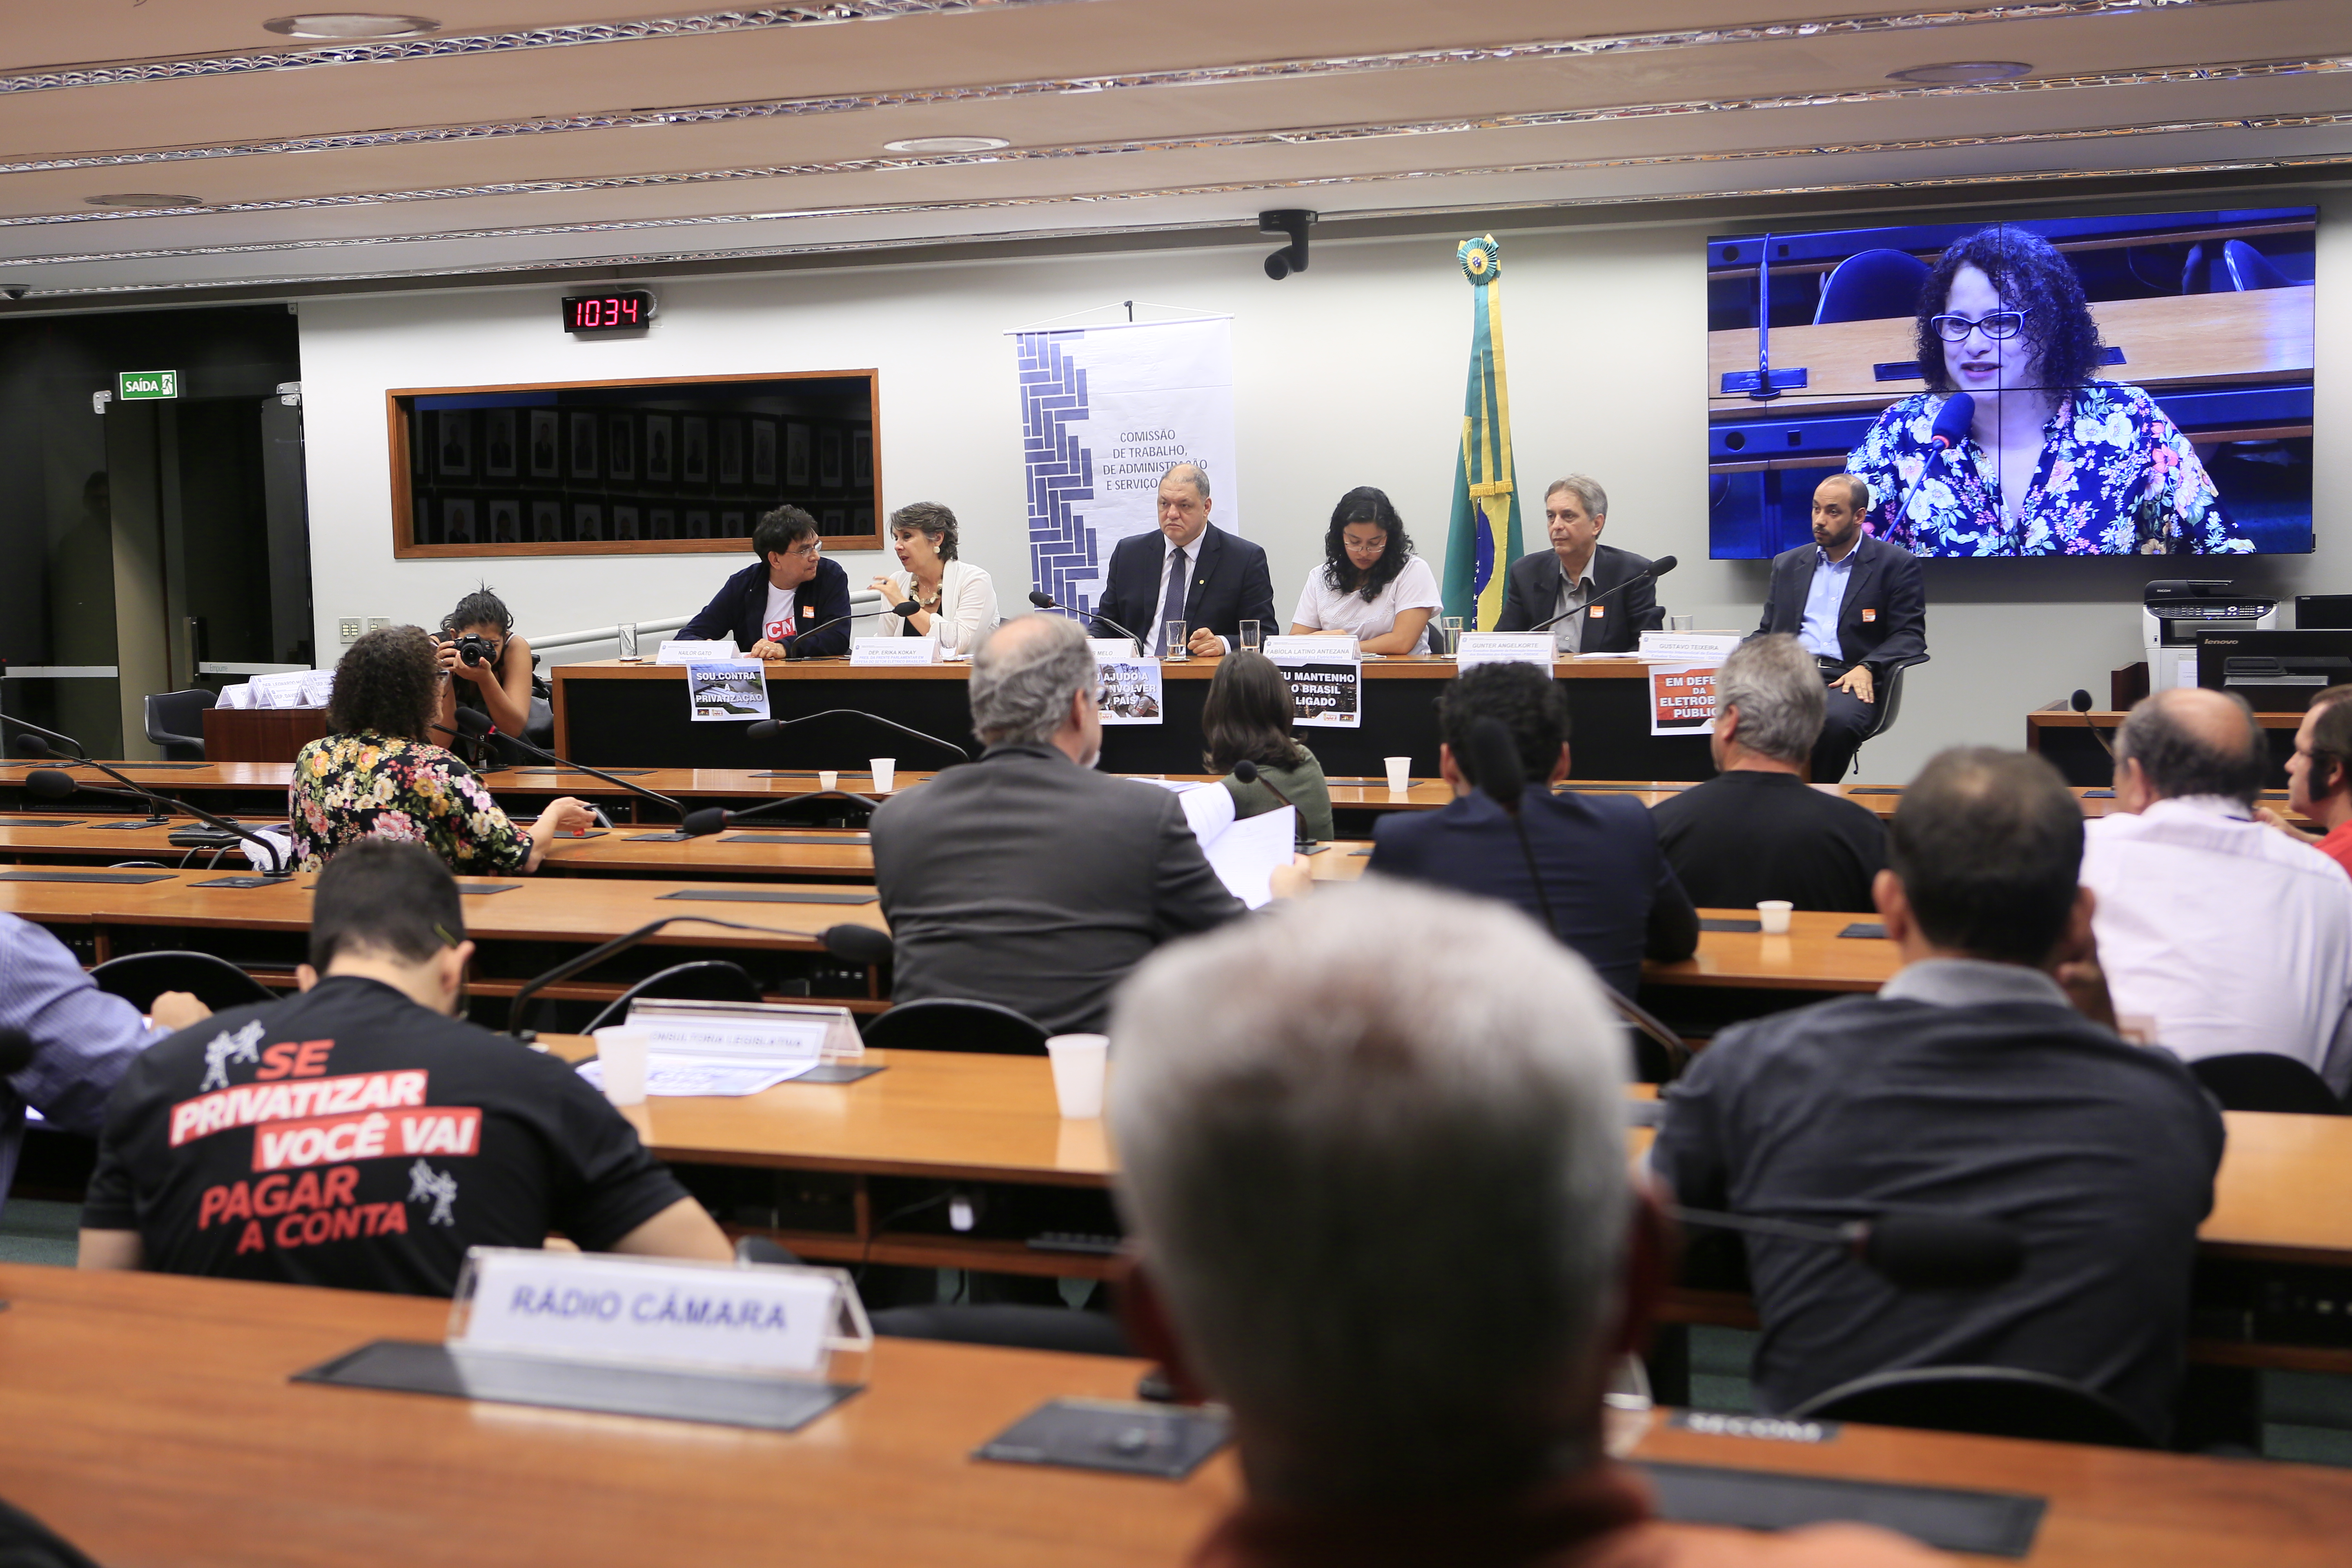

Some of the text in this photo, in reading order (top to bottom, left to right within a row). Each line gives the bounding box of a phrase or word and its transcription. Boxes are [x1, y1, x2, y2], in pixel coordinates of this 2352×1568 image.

[125, 378, 159, 392] SAÍDA
[1120, 429, 1176, 443] COMISSÃO
[1113, 445, 1187, 459] DE TRABALHO,
[1103, 459, 1207, 475] DE ADMINISTÃO
[1107, 478, 1158, 491] E SERVIÇO
[209, 664, 228, 673] Empurre
[697, 672, 756, 681] SOU CONTRA
[1104, 673, 1139, 681] AJUDO
[1141, 673, 1149, 681] A
[1294, 672, 1355, 683] MANTENHO
[1665, 676, 1717, 687] EM DEFE
[1291, 684, 1341, 694] O BRASIL
[696, 692, 763, 704] PRIVATIZAÇÃO
[1296, 697, 1336, 706] LIGADO
[1659, 695, 1716, 707] ELETROB
[256, 1039, 336, 1080] SE
[171, 1071, 427, 1146] PRIVATIZAR
[261, 1111, 477, 1170] VOCÊ VAI
[198, 1165, 360, 1231] PAGAR
[236, 1201, 408, 1256] A CONTA
[510, 1281, 787, 1330] RÁDIO CÂMARA
